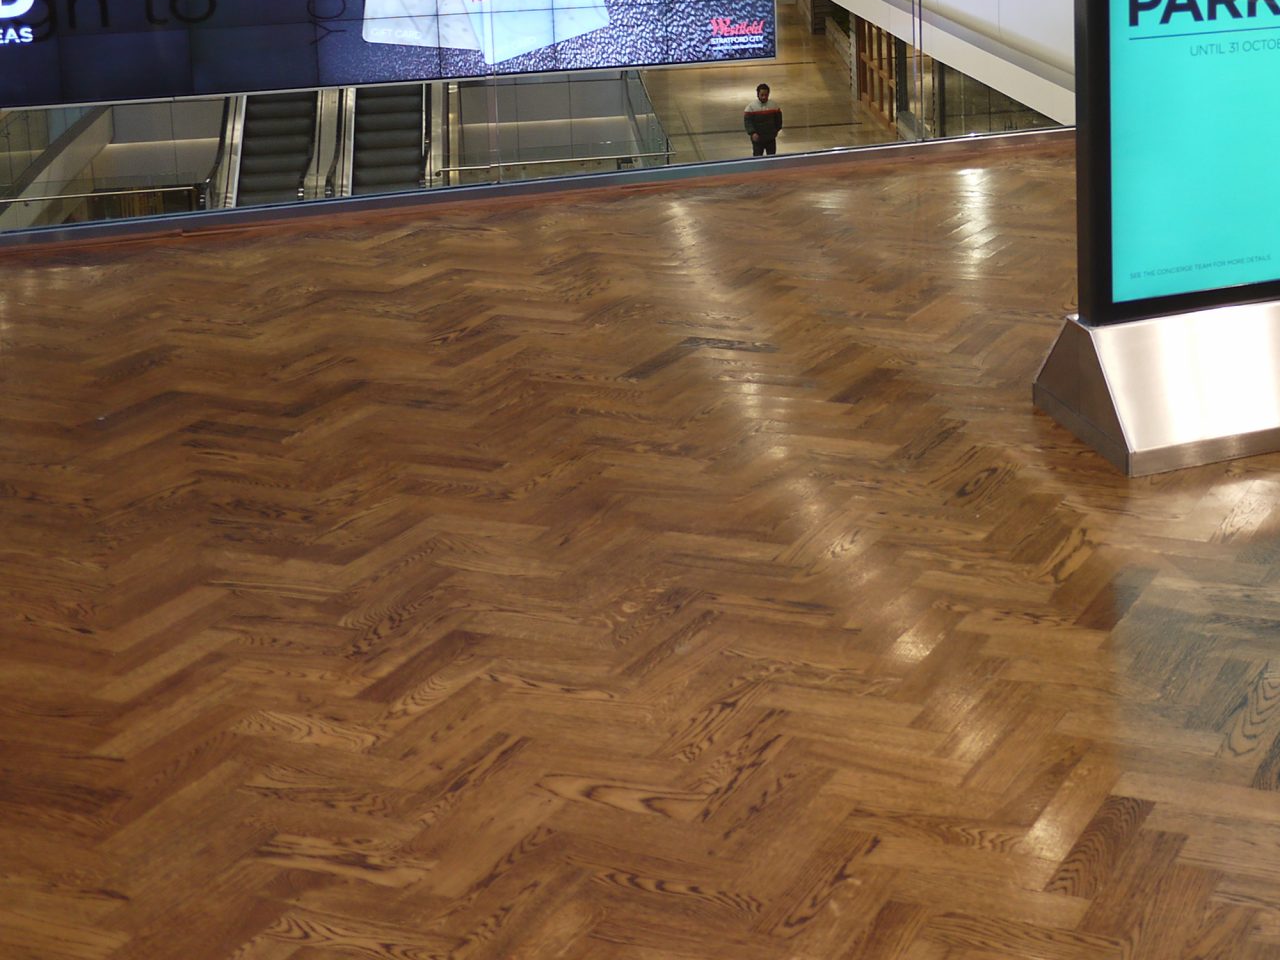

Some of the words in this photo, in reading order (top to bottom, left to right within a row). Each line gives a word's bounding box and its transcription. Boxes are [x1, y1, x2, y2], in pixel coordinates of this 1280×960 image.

[710, 17, 765, 37] Westfield
[711, 36, 749, 45] STRATFORD
[749, 35, 763, 43] CITY
[1190, 43, 1225, 57] UNTIL
[1228, 42, 1239, 53] 31
[1130, 271, 1141, 279] SEE
[1156, 265, 1193, 276] CONCIERGE
[1194, 262, 1212, 271] TEAM
